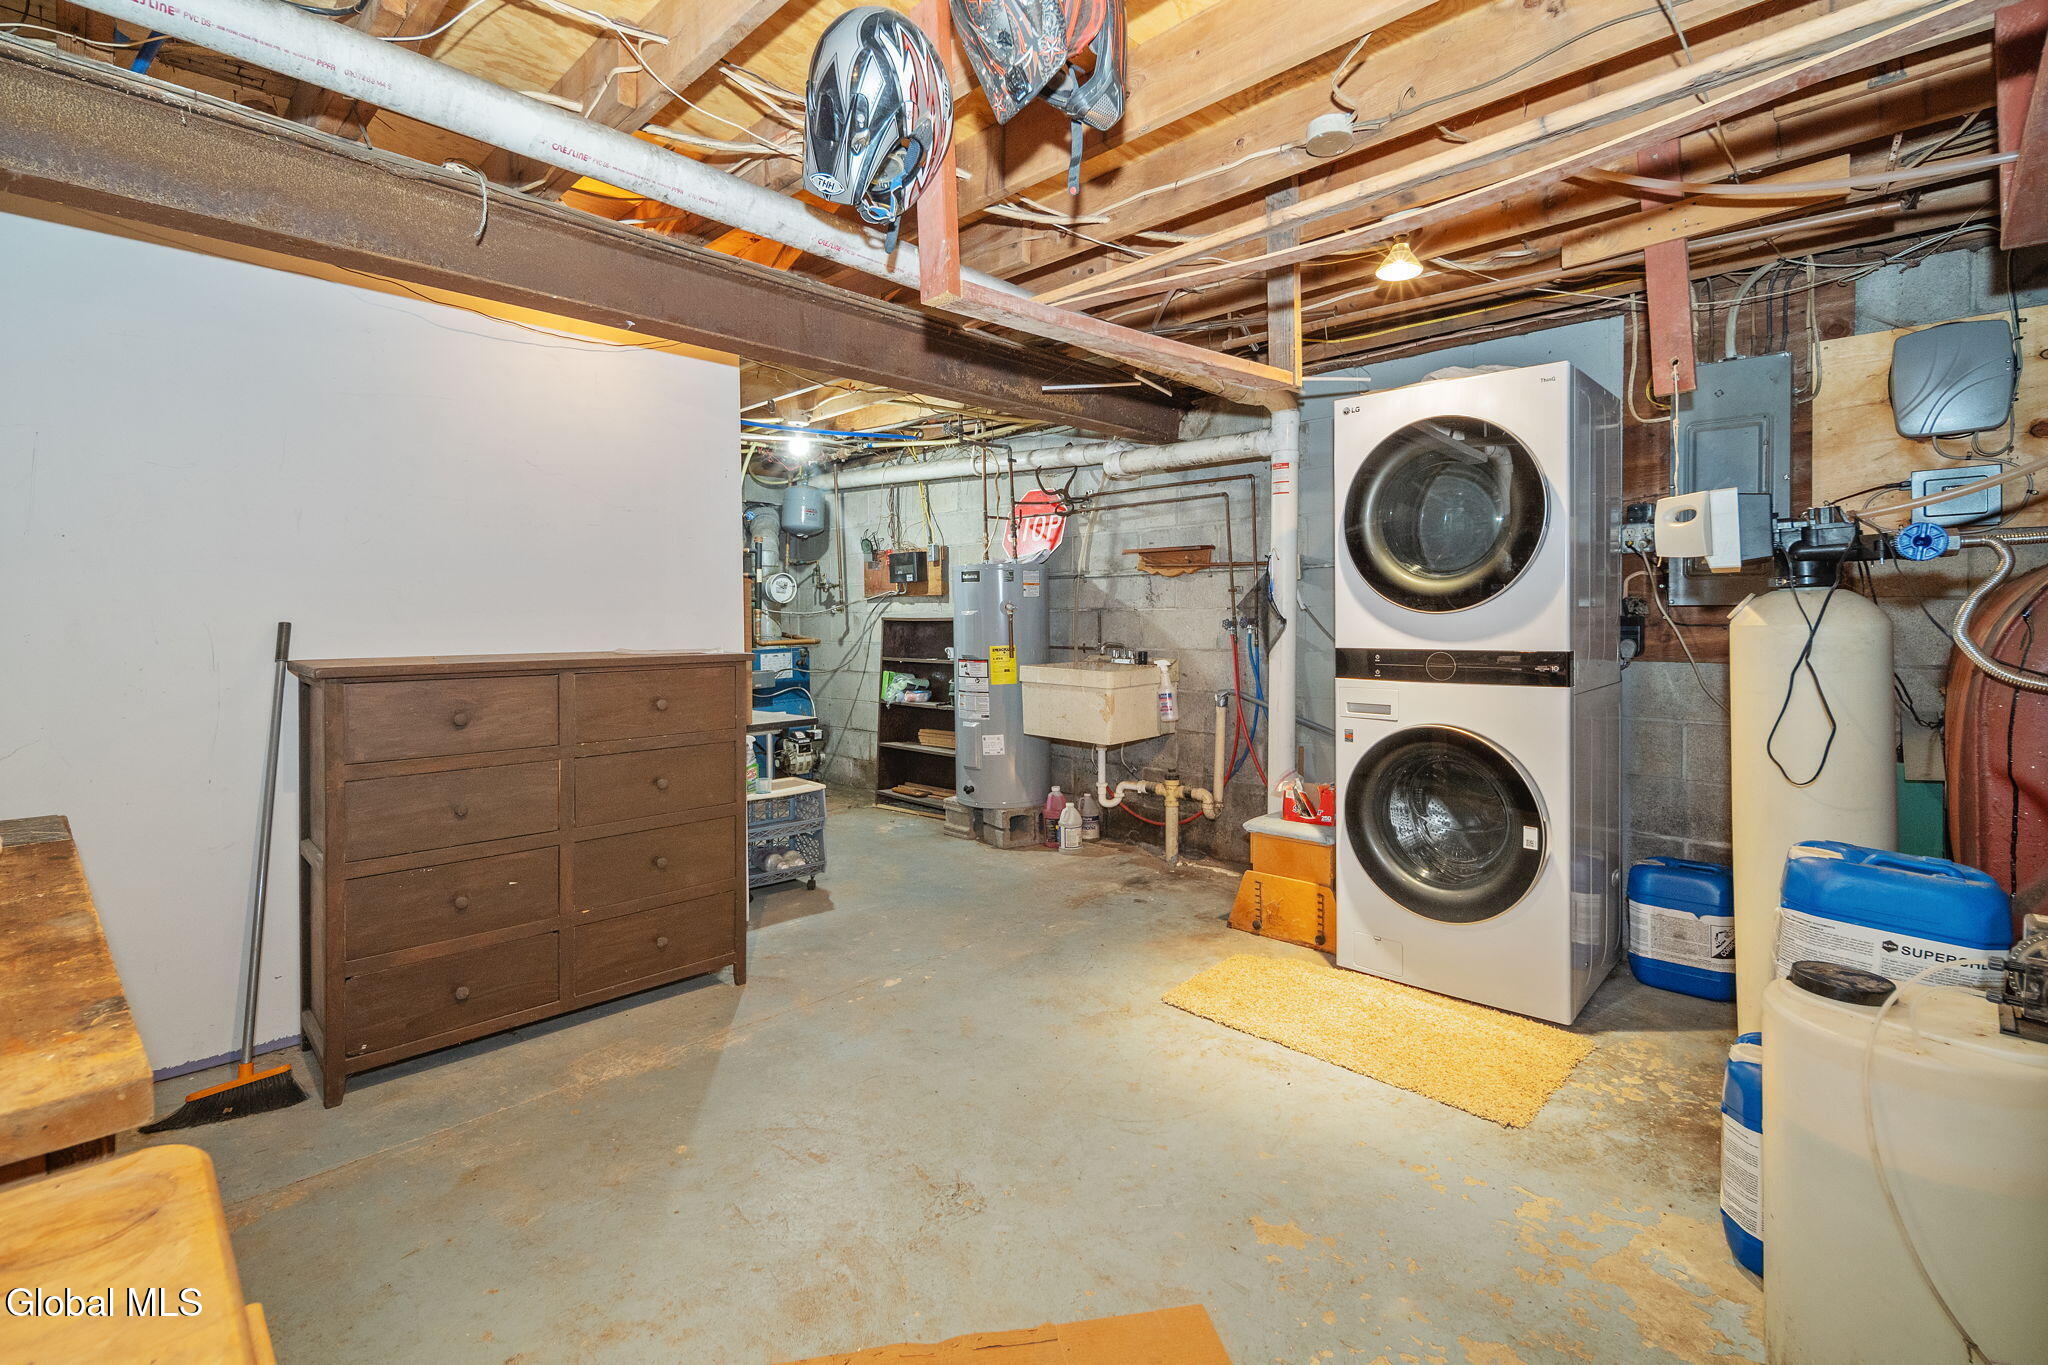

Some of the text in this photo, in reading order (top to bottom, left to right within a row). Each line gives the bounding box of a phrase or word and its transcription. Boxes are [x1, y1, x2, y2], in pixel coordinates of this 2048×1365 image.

[183, 11, 199, 23] PVC
[552, 143, 588, 162] CRESLINE
[1351, 406, 1360, 414] LG
